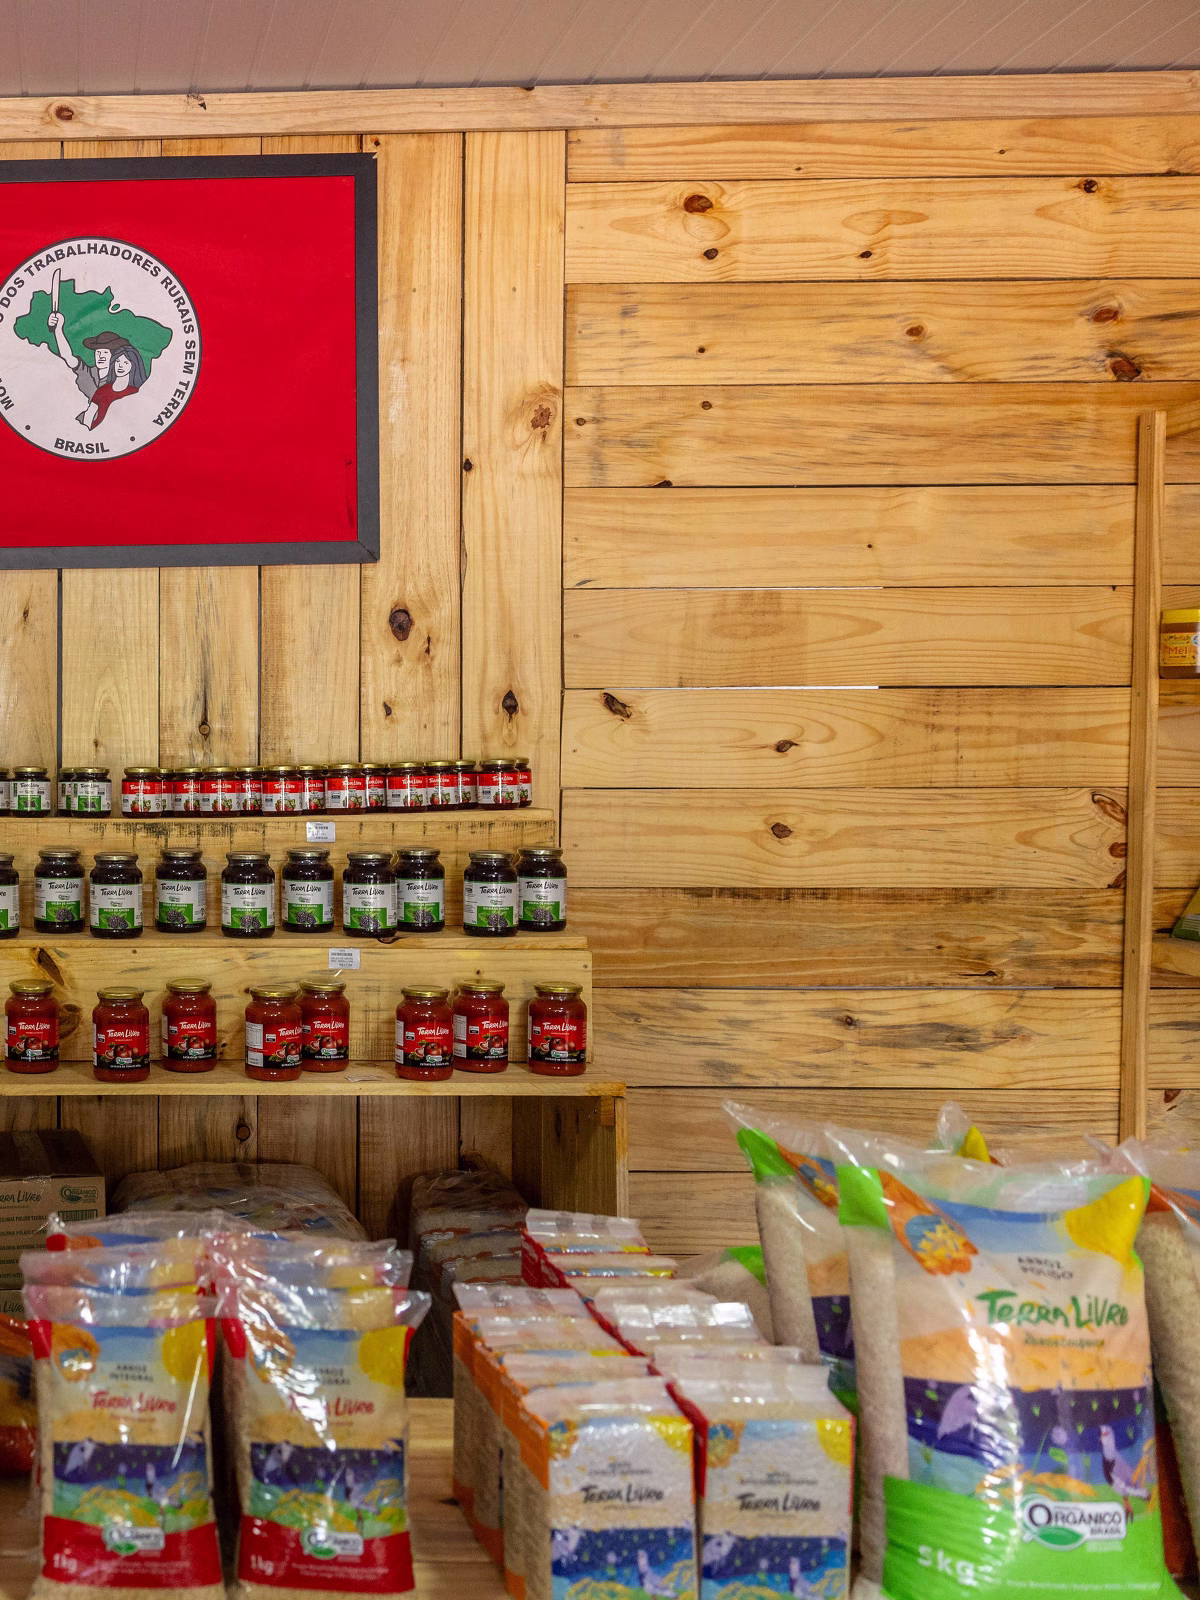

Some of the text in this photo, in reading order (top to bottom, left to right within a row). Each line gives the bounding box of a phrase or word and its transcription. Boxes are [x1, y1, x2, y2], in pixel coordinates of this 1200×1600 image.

[24, 242, 162, 278] TRABALHADORES
[160, 275, 195, 335] RURAIS
[183, 339, 196, 375] SEM
[152, 379, 190, 427] TERRA
[54, 437, 110, 454] BRASIL
[1028, 1503, 1122, 1528] ORGÂNICO
